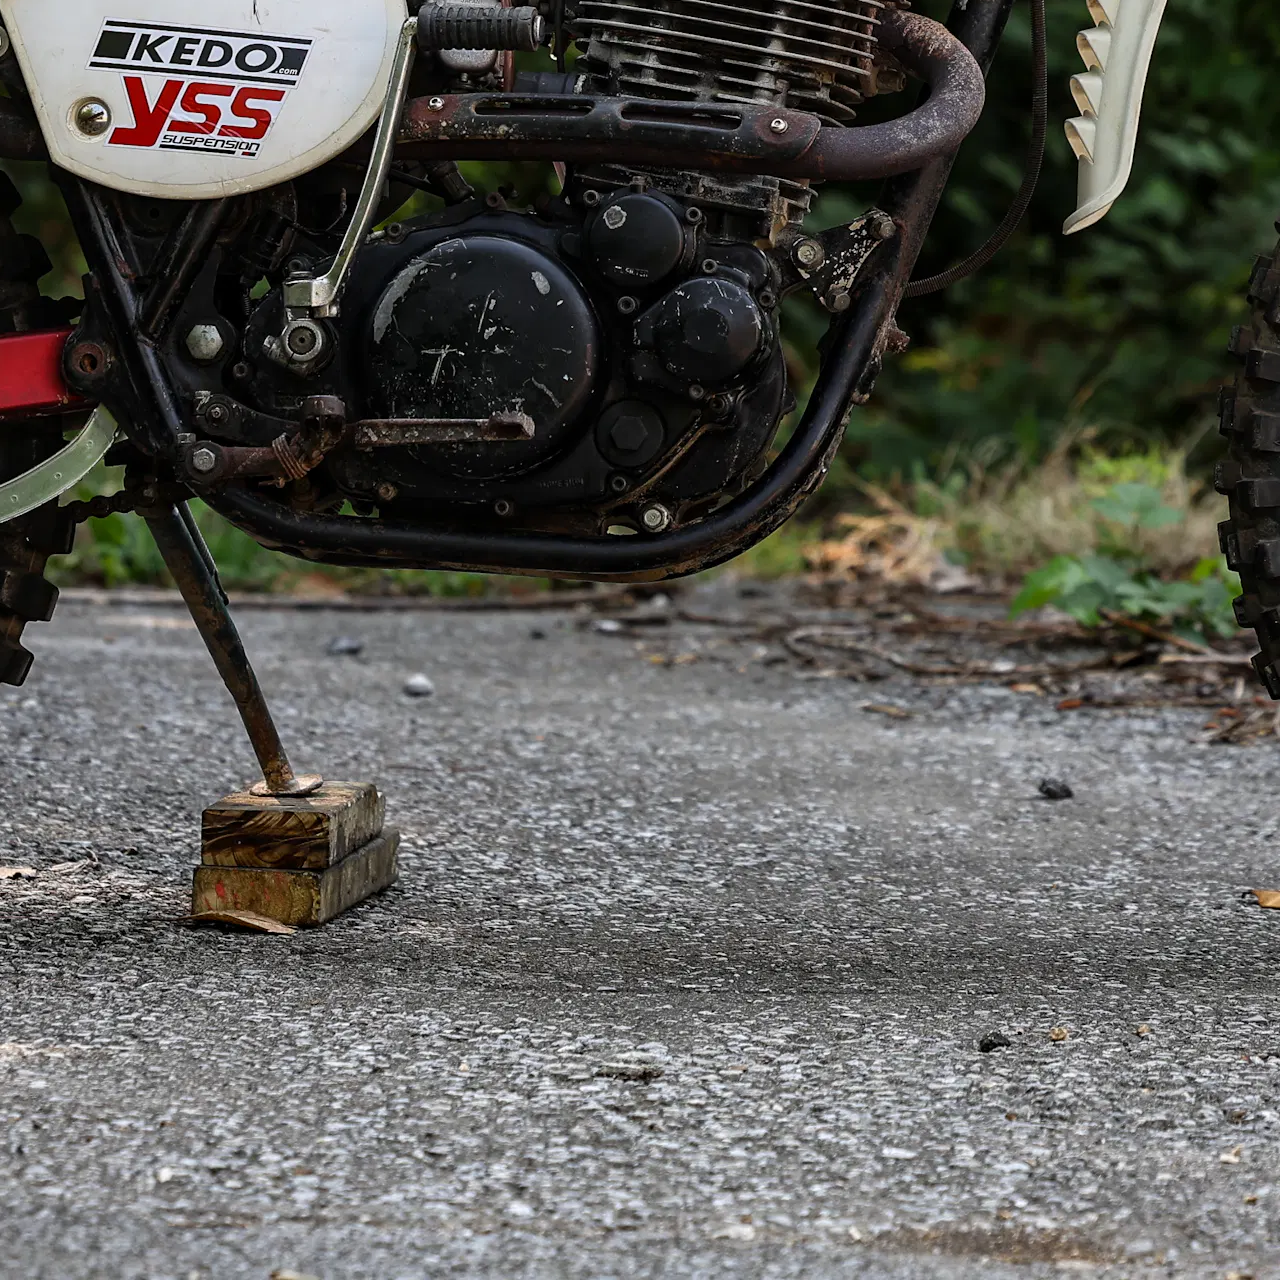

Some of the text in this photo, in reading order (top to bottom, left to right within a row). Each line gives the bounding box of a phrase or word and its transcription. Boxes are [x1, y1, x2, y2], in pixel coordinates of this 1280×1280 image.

[131, 33, 298, 76] KEDO .com
[108, 75, 286, 147] YSS
